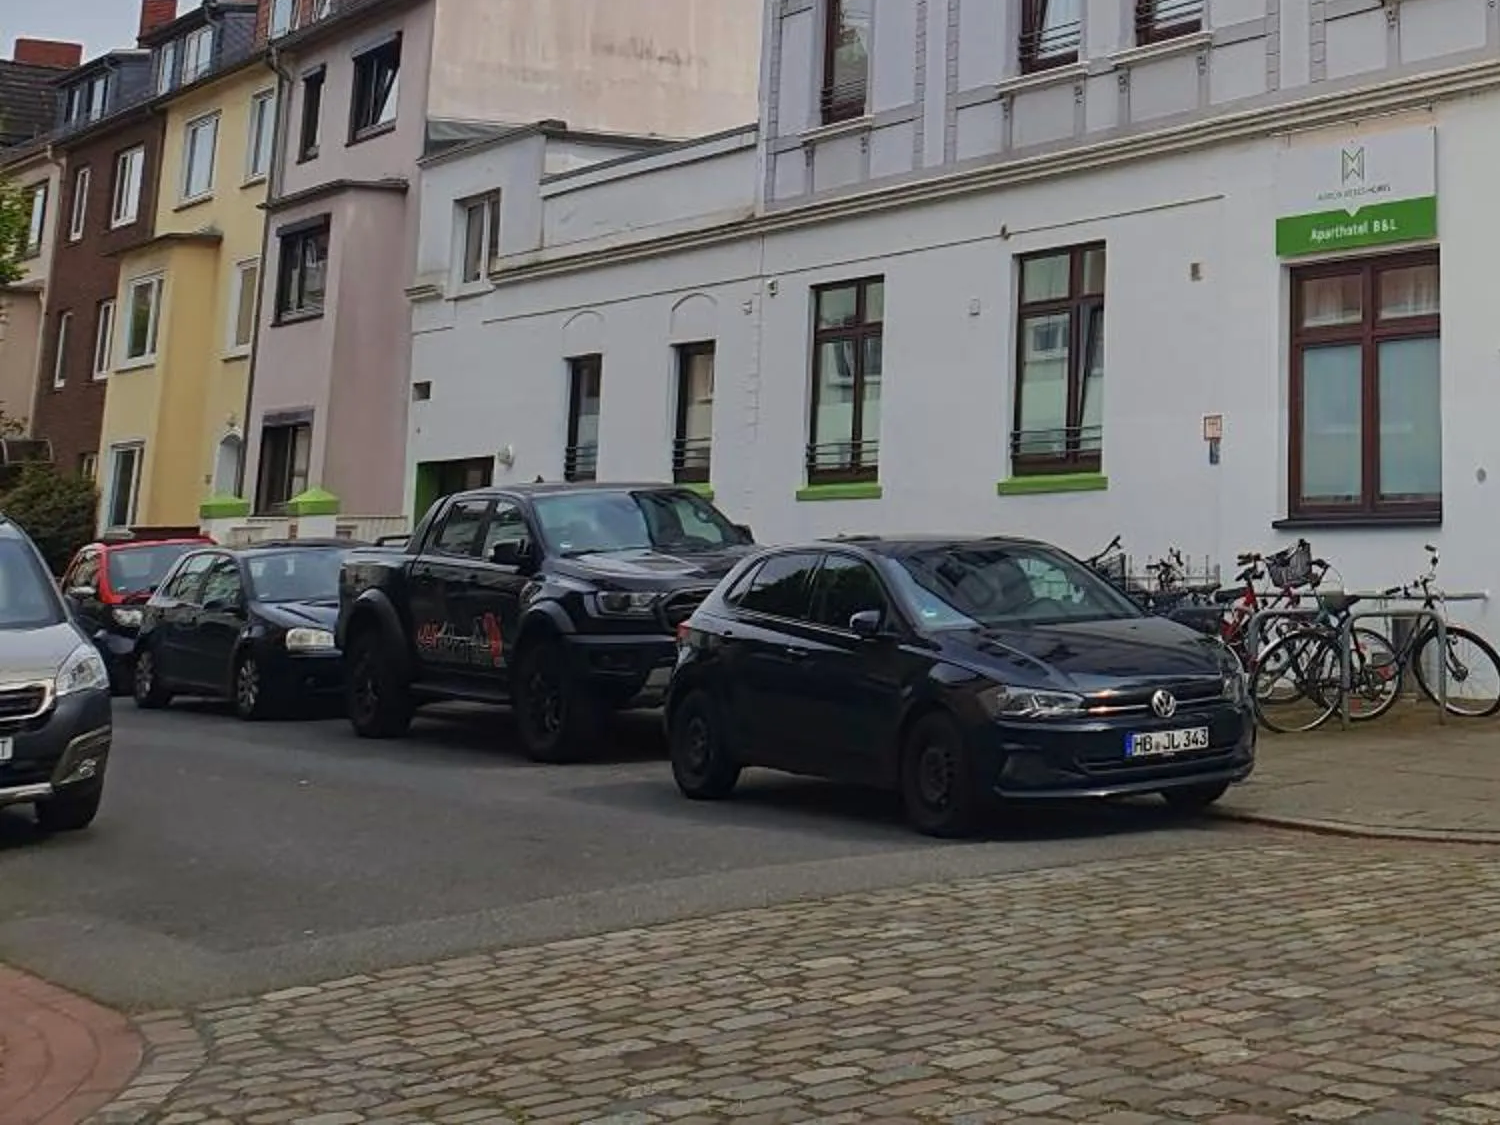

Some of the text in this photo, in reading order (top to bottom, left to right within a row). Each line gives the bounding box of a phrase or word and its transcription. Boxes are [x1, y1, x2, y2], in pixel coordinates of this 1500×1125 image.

[1311, 220, 1369, 243] Aparthotel
[1134, 728, 1207, 755] HB JL 343
